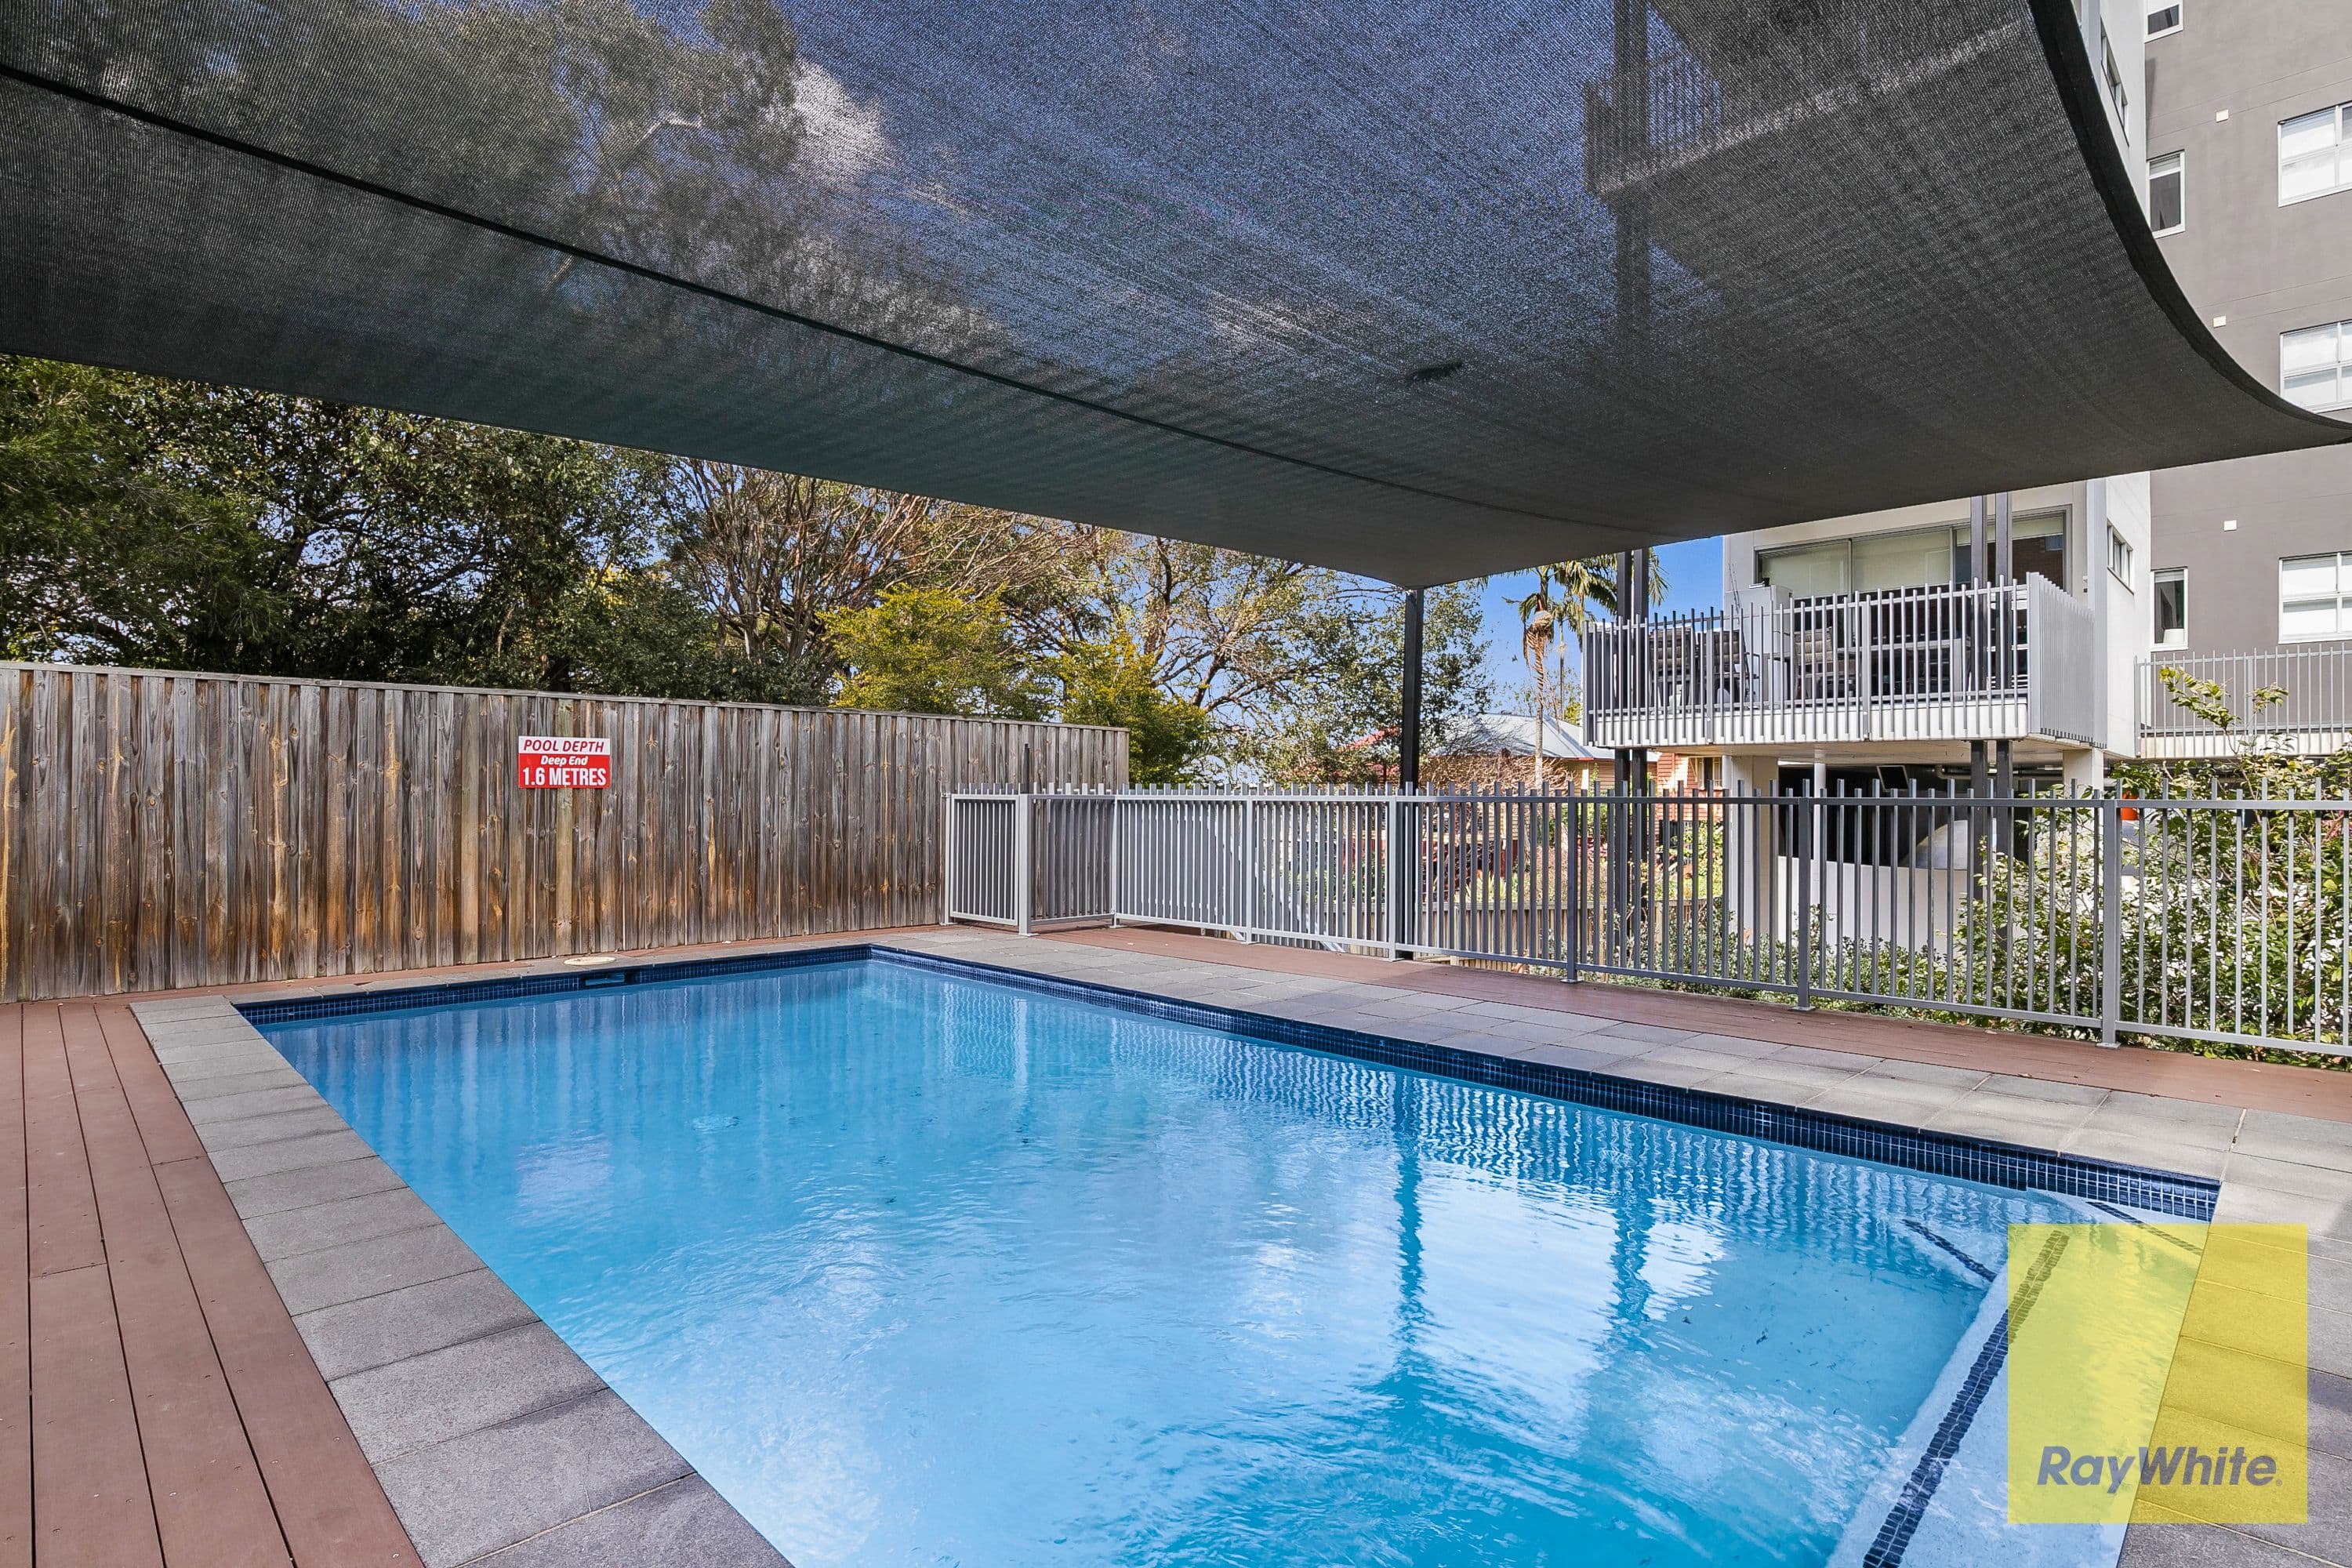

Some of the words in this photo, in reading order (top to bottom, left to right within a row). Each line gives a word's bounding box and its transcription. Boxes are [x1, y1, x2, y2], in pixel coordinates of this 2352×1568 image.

[524, 739, 558, 751] POOL
[562, 741, 604, 752] DEPTH
[540, 755, 567, 767] Deep
[568, 757, 589, 765] End
[523, 768, 545, 786] 1.6
[549, 768, 607, 786] METRES
